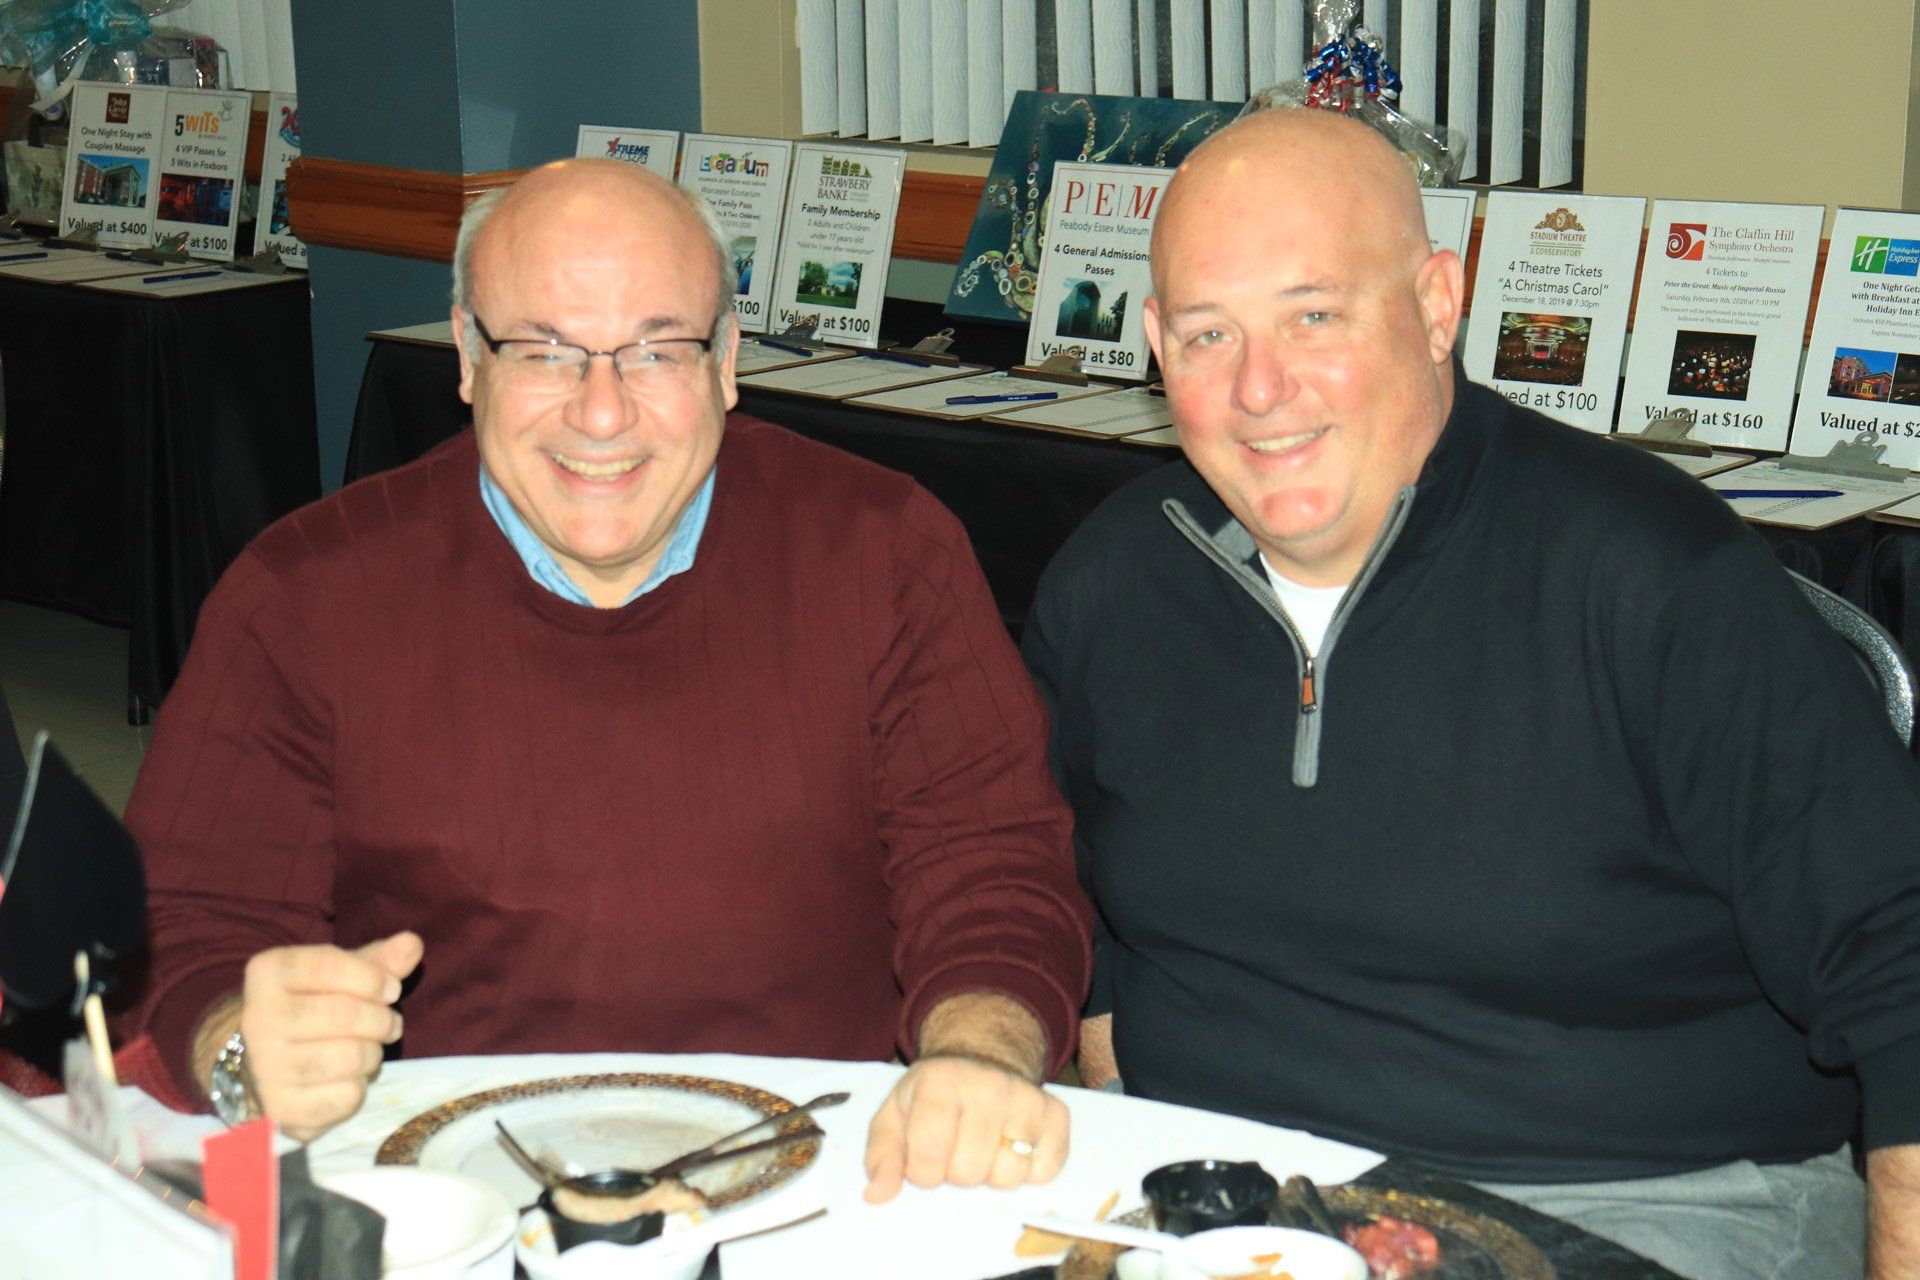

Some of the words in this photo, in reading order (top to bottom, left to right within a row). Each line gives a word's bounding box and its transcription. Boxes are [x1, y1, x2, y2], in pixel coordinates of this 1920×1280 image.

[81, 127, 96, 136] One
[98, 128, 118, 138] Night
[120, 130, 135, 140] Stay
[137, 131, 152, 139] with
[85, 140, 113, 152] Couples
[115, 142, 145, 154] Massage
[176, 144, 179, 152] 4
[182, 145, 192, 153] VIP
[194, 146, 215, 156] Passes
[217, 147, 227, 156] for
[177, 158, 191, 168] Wits
[193, 160, 199, 168] in
[200, 161, 228, 171] Foxboro
[820, 176, 872, 190] STRAWBERY
[818, 188, 848, 201] BANKE
[718, 200, 737, 210] Family
[738, 201, 752, 209] Pass
[802, 203, 828, 216] Family
[830, 206, 880, 222] Membership
[106, 222, 117, 233] at
[120, 222, 146, 235] $400
[813, 220, 831, 228] Adults
[845, 222, 870, 232] Children
[1060, 220, 1092, 233] Peabody
[1094, 222, 1114, 232] Essex
[1117, 225, 1149, 236] Museum
[1530, 232, 1558, 240] STADIUM
[1560, 234, 1587, 242] THEATRE
[1711, 226, 1732, 238] The
[1736, 228, 1770, 240] Claflin
[1775, 229, 1794, 241] Hill
[190, 238, 200, 248] at
[203, 236, 227, 250] $100
[1709, 240, 1752, 254] Symphony
[1754, 243, 1793, 253] Orchestra
[1054, 244, 1060, 253] 4
[1063, 245, 1098, 257] General
[1536, 248, 1582, 256] CONSERVATORY
[1891, 246, 1910, 254] Holiday
[1889, 253, 1918, 264] Express
[1085, 264, 1115, 275] Passes
[1509, 261, 1515, 272] 4
[1520, 261, 1560, 275] Theatre
[1565, 264, 1603, 277] Tickets
[1712, 268, 1738, 277] Tickets
[1515, 279, 1569, 294] Christmas
[1863, 281, 1879, 289] One
[1881, 283, 1902, 292] Night
[1502, 294, 1535, 304] December
[1548, 297, 1565, 306] 2019
[1871, 294, 1910, 304] Breakfast
[1866, 305, 1898, 316] Holiday
[824, 317, 836, 329] at
[840, 316, 870, 333] $100
[1091, 350, 1104, 363] at
[1108, 349, 1134, 366] $80
[1534, 392, 1550, 407] at
[1556, 391, 1597, 411] $100
[1702, 412, 1718, 425] at
[1722, 412, 1763, 429] $160
[1820, 412, 1878, 432] Valued
[1882, 420, 1900, 435] at
